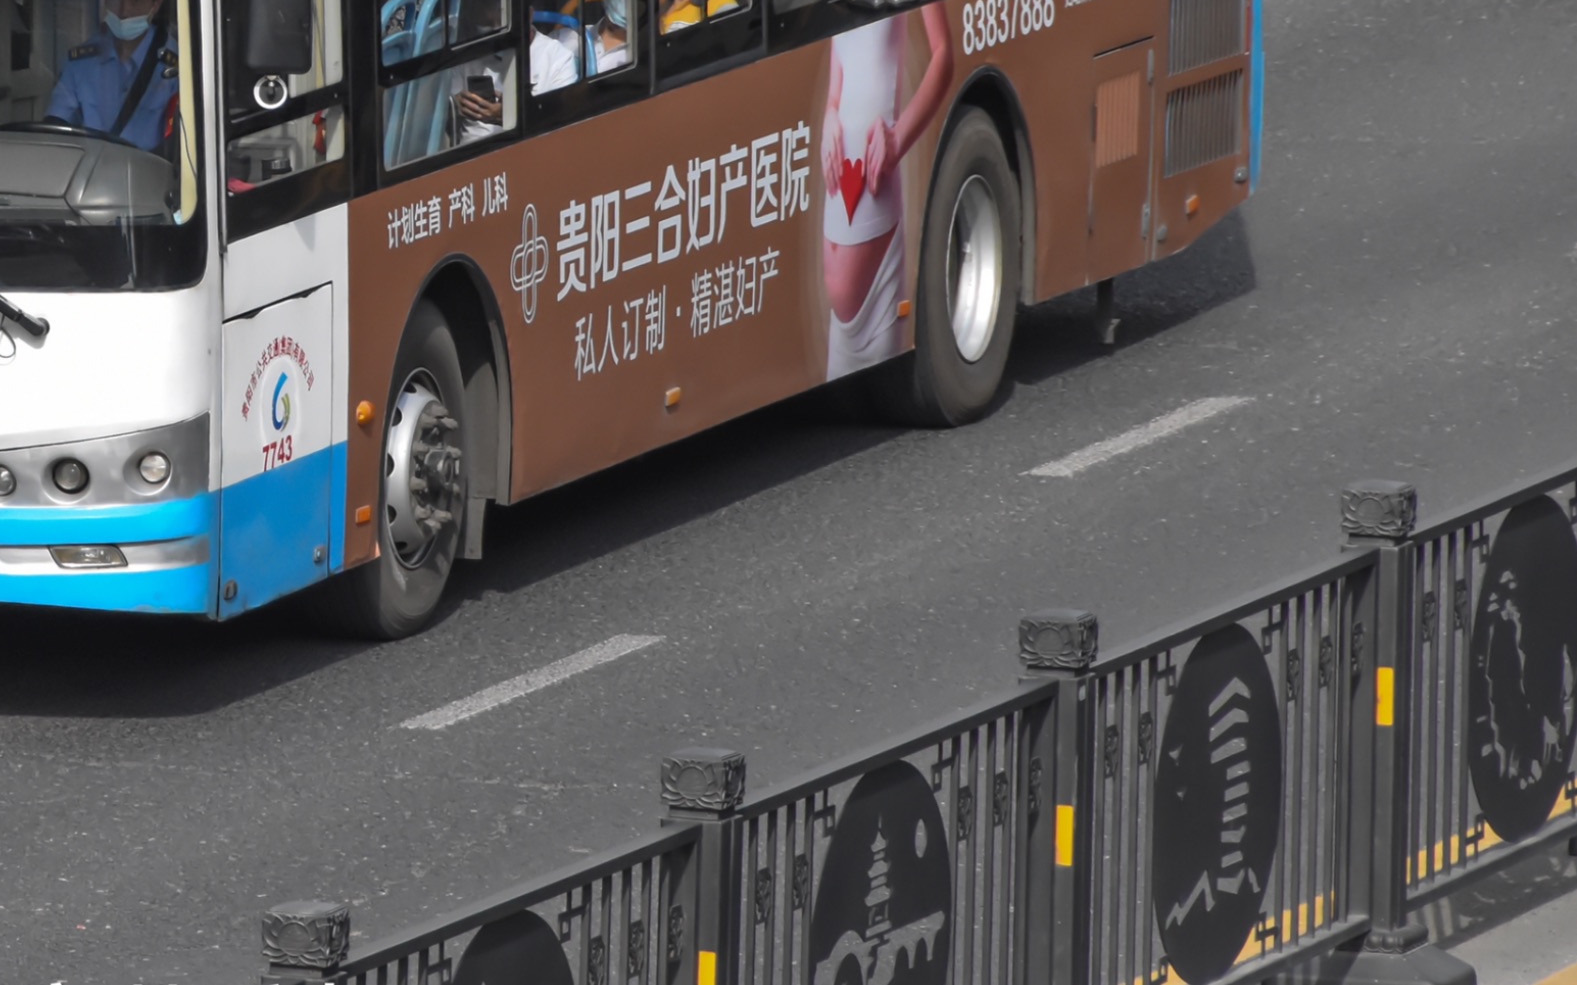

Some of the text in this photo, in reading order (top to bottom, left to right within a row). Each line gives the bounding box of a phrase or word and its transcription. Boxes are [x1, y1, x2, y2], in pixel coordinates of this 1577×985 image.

[387, 171, 509, 250] 计划生育 产科 儿科
[555, 120, 812, 302] 贵阳三合妇产医院
[262, 434, 294, 473] 7743
